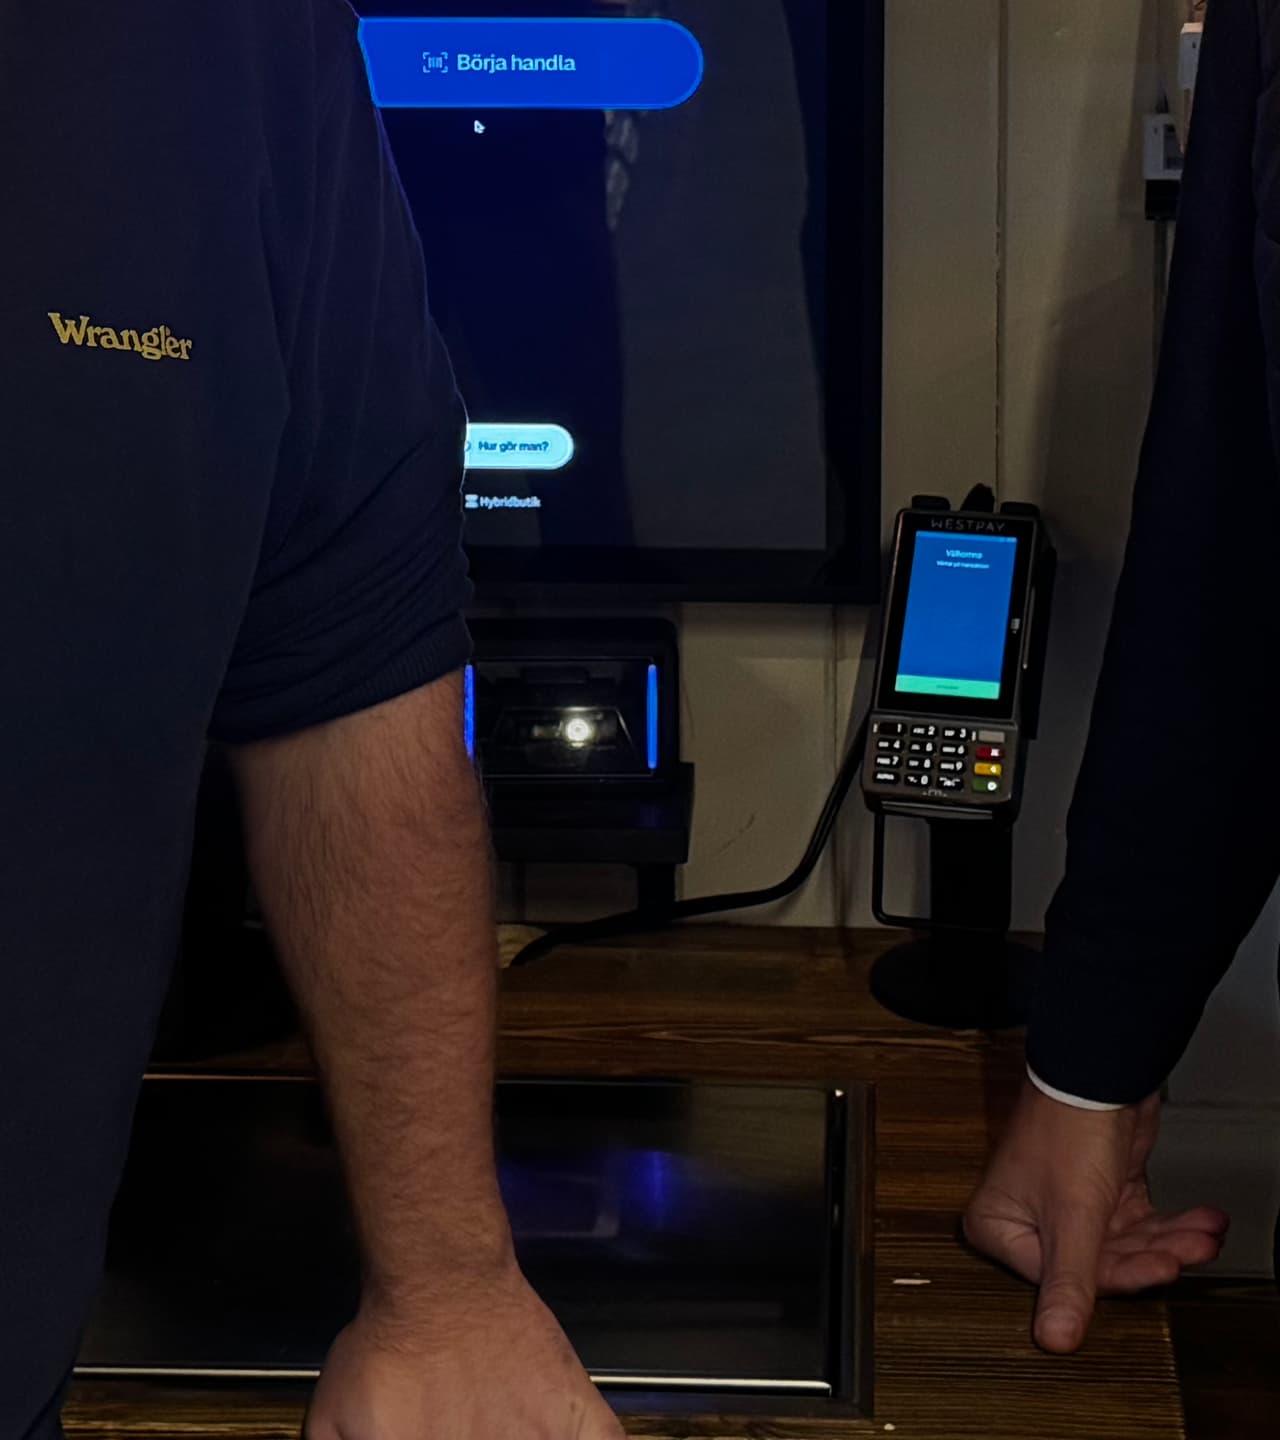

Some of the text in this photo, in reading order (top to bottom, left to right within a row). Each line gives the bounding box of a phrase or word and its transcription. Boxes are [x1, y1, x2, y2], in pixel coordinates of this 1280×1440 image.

[457, 53, 577, 74] Börja handla
[47, 312, 193, 361] Wrangler
[478, 441, 549, 453] Hur gör man?
[480, 495, 542, 510] Hybridbutik
[930, 518, 1006, 532] WESTPAY
